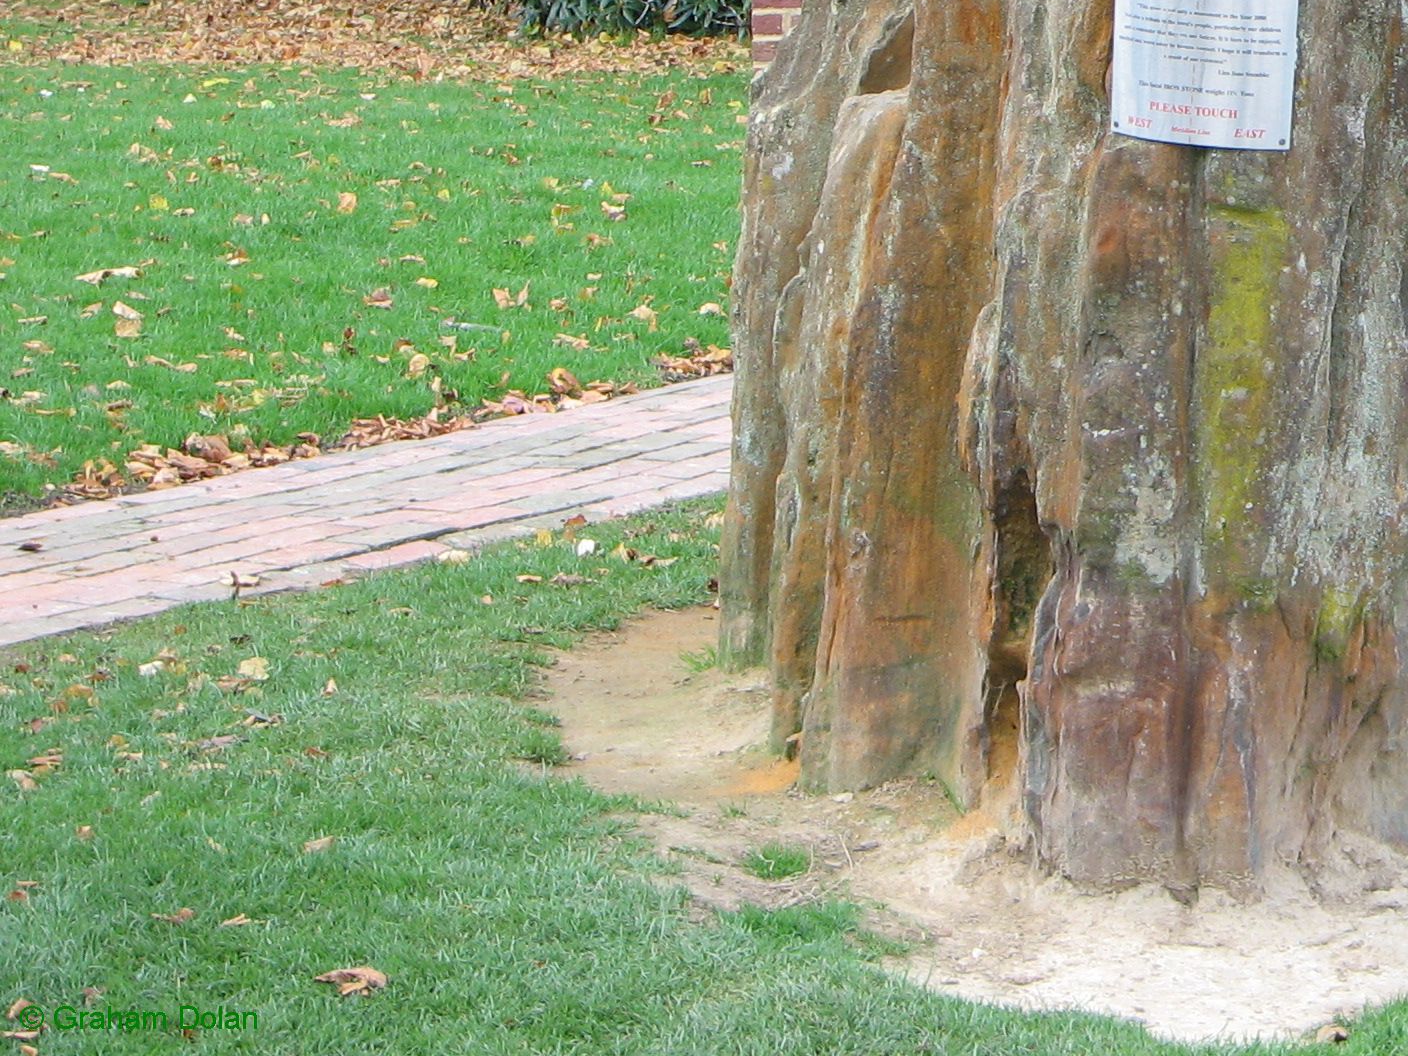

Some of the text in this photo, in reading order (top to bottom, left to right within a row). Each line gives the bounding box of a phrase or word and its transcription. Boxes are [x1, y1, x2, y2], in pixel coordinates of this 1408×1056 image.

[1149, 101, 1238, 119] PLEASE TOUCH
[1128, 115, 1152, 129] WEST
[1234, 128, 1266, 139] EAST
